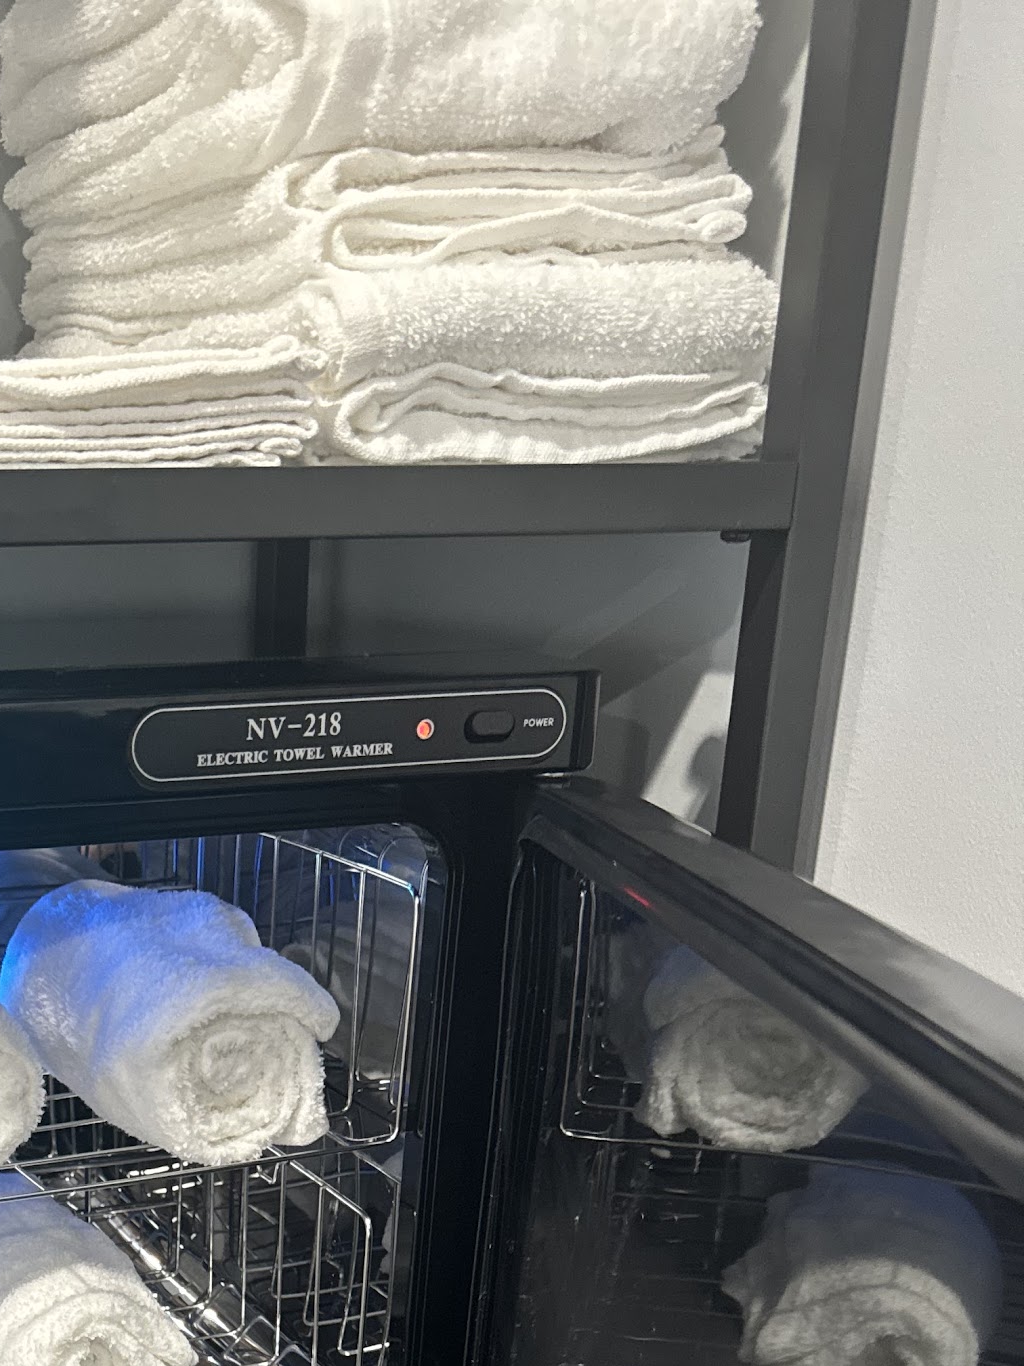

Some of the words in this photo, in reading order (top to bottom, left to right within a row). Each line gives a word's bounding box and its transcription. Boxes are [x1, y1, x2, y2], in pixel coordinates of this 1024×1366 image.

[246, 712, 342, 741] NV-218
[523, 717, 555, 728] POWER
[197, 751, 268, 767] ELECTRIC
[274, 747, 325, 762] TOWEL
[331, 742, 393, 758] WARMER
